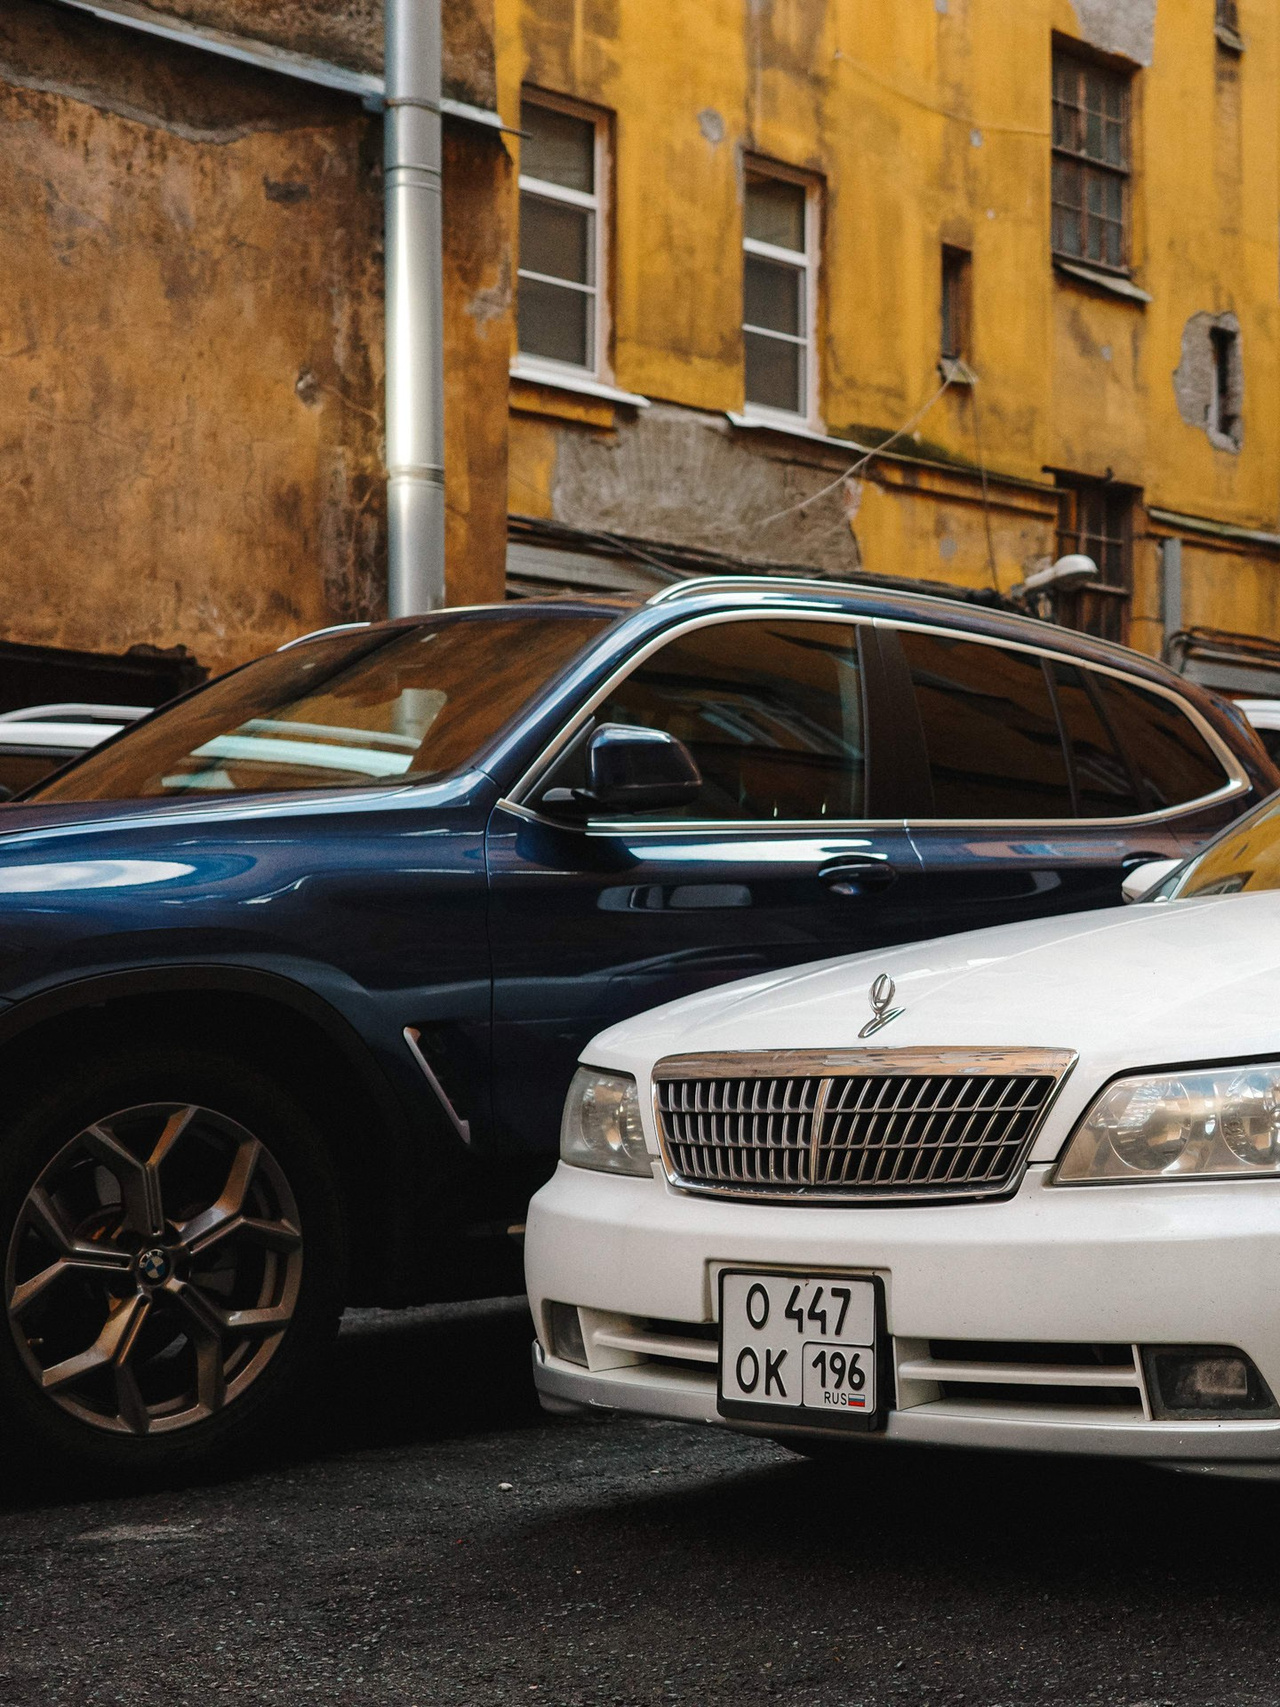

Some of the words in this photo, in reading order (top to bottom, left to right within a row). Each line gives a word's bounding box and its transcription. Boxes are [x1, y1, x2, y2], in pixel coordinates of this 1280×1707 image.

[784, 1285, 852, 1336] 447
[811, 1350, 866, 1391] 196
[824, 1391, 848, 1405] RUS
